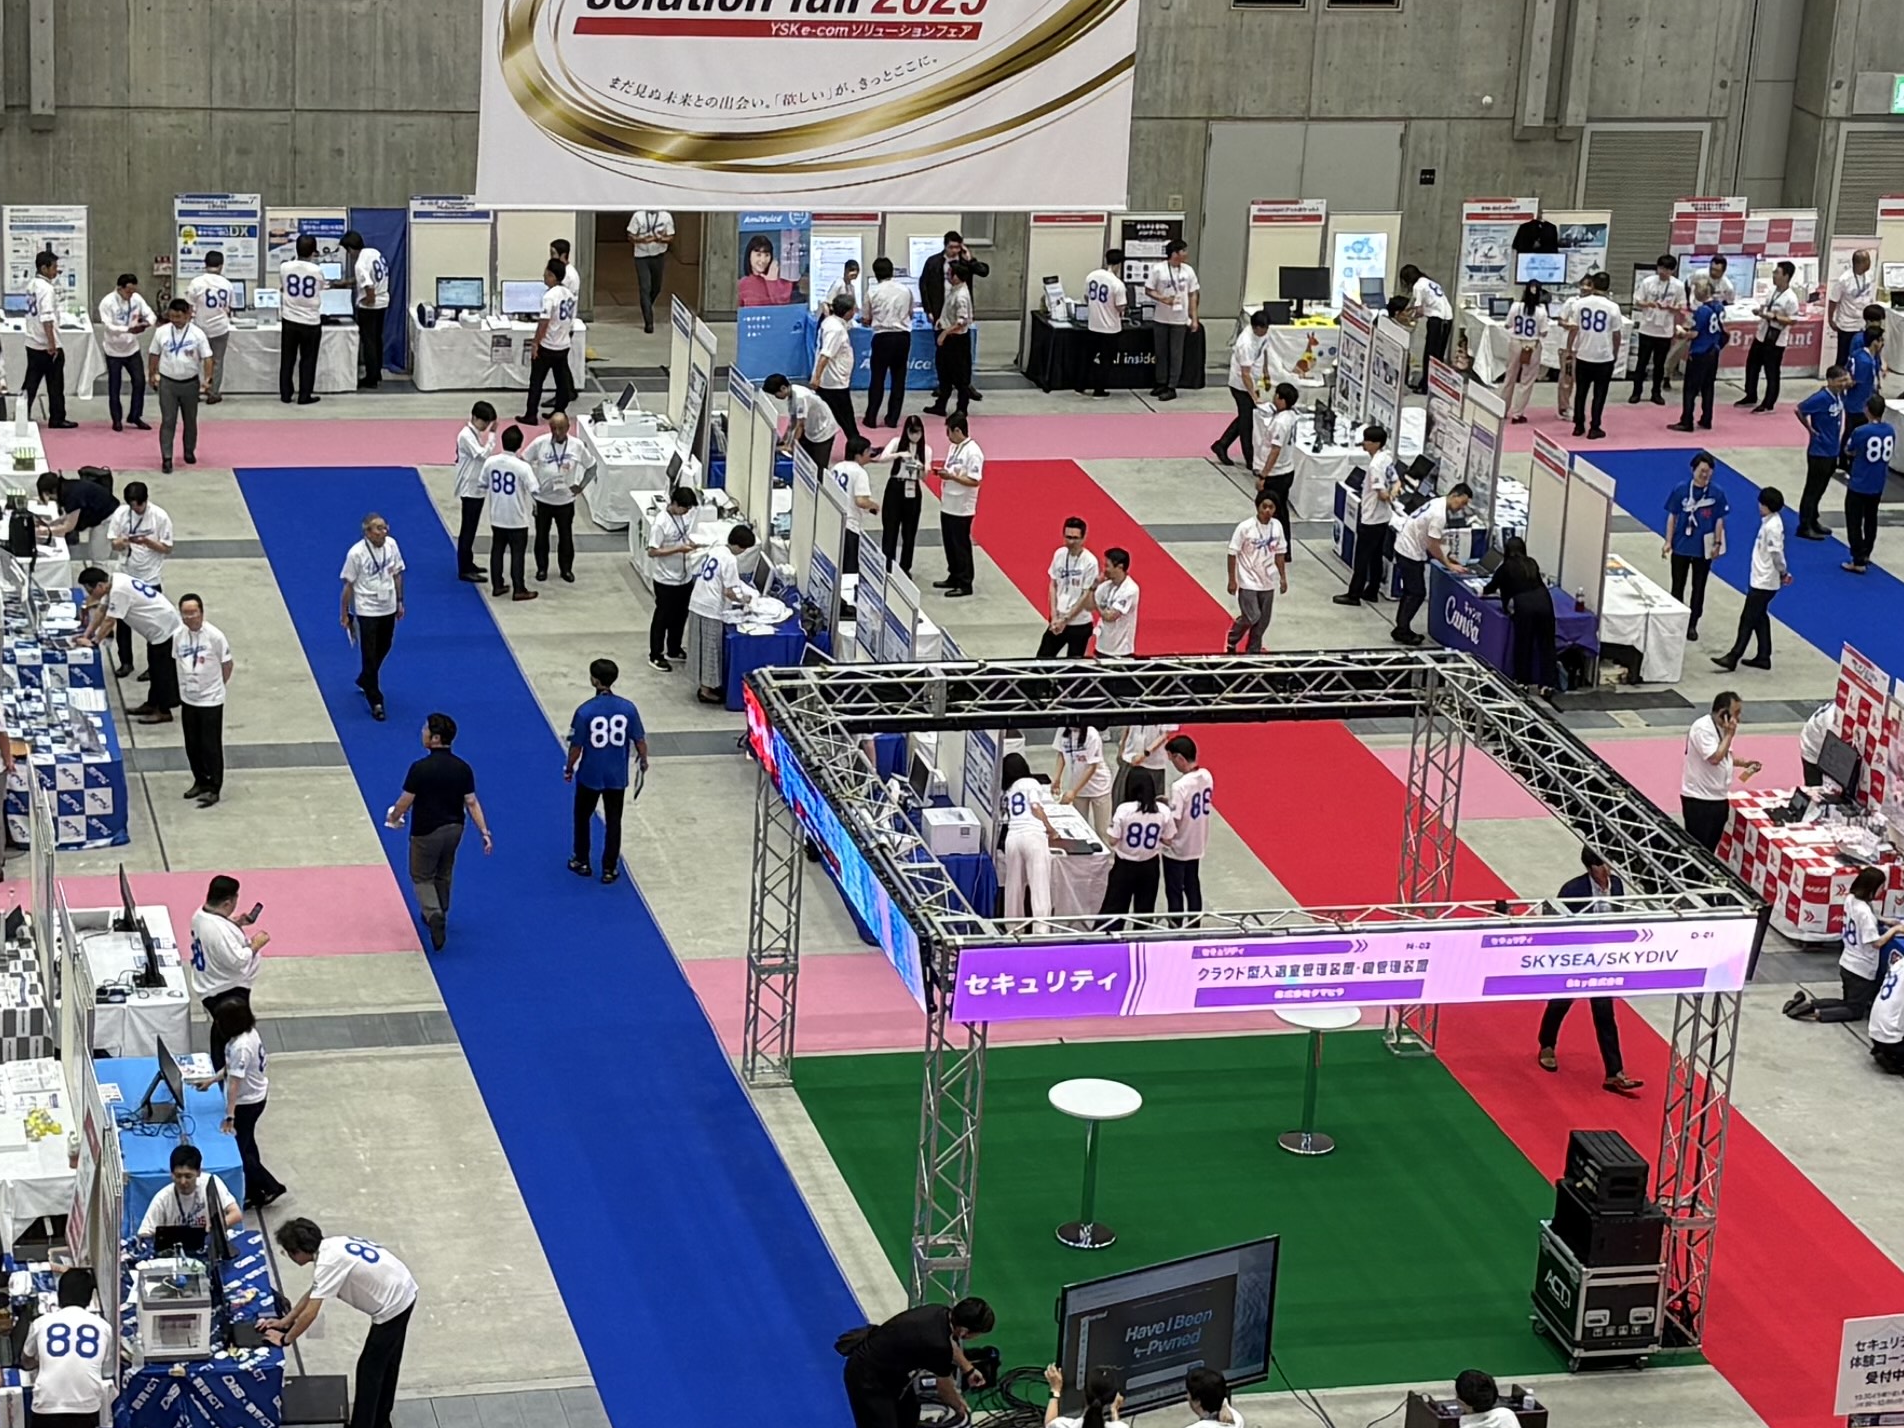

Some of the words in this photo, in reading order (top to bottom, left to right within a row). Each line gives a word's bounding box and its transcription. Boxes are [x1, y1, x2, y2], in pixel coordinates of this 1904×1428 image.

[851, 22, 973, 40] ソリューションフェア
[285, 273, 317, 300] 88
[1086, 279, 1109, 305] 88
[1579, 307, 1608, 333] 88
[1865, 435, 1896, 462] 88
[489, 470, 516, 496] 88
[1445, 595, 1480, 645] Canva
[589, 713, 628, 749] 88
[1125, 821, 1161, 850] 88
[1520, 949, 1679, 970] SKYSEA/SKYDIV
[964, 968, 1120, 998] セキュリティ
[45, 1322, 100, 1357] 88
